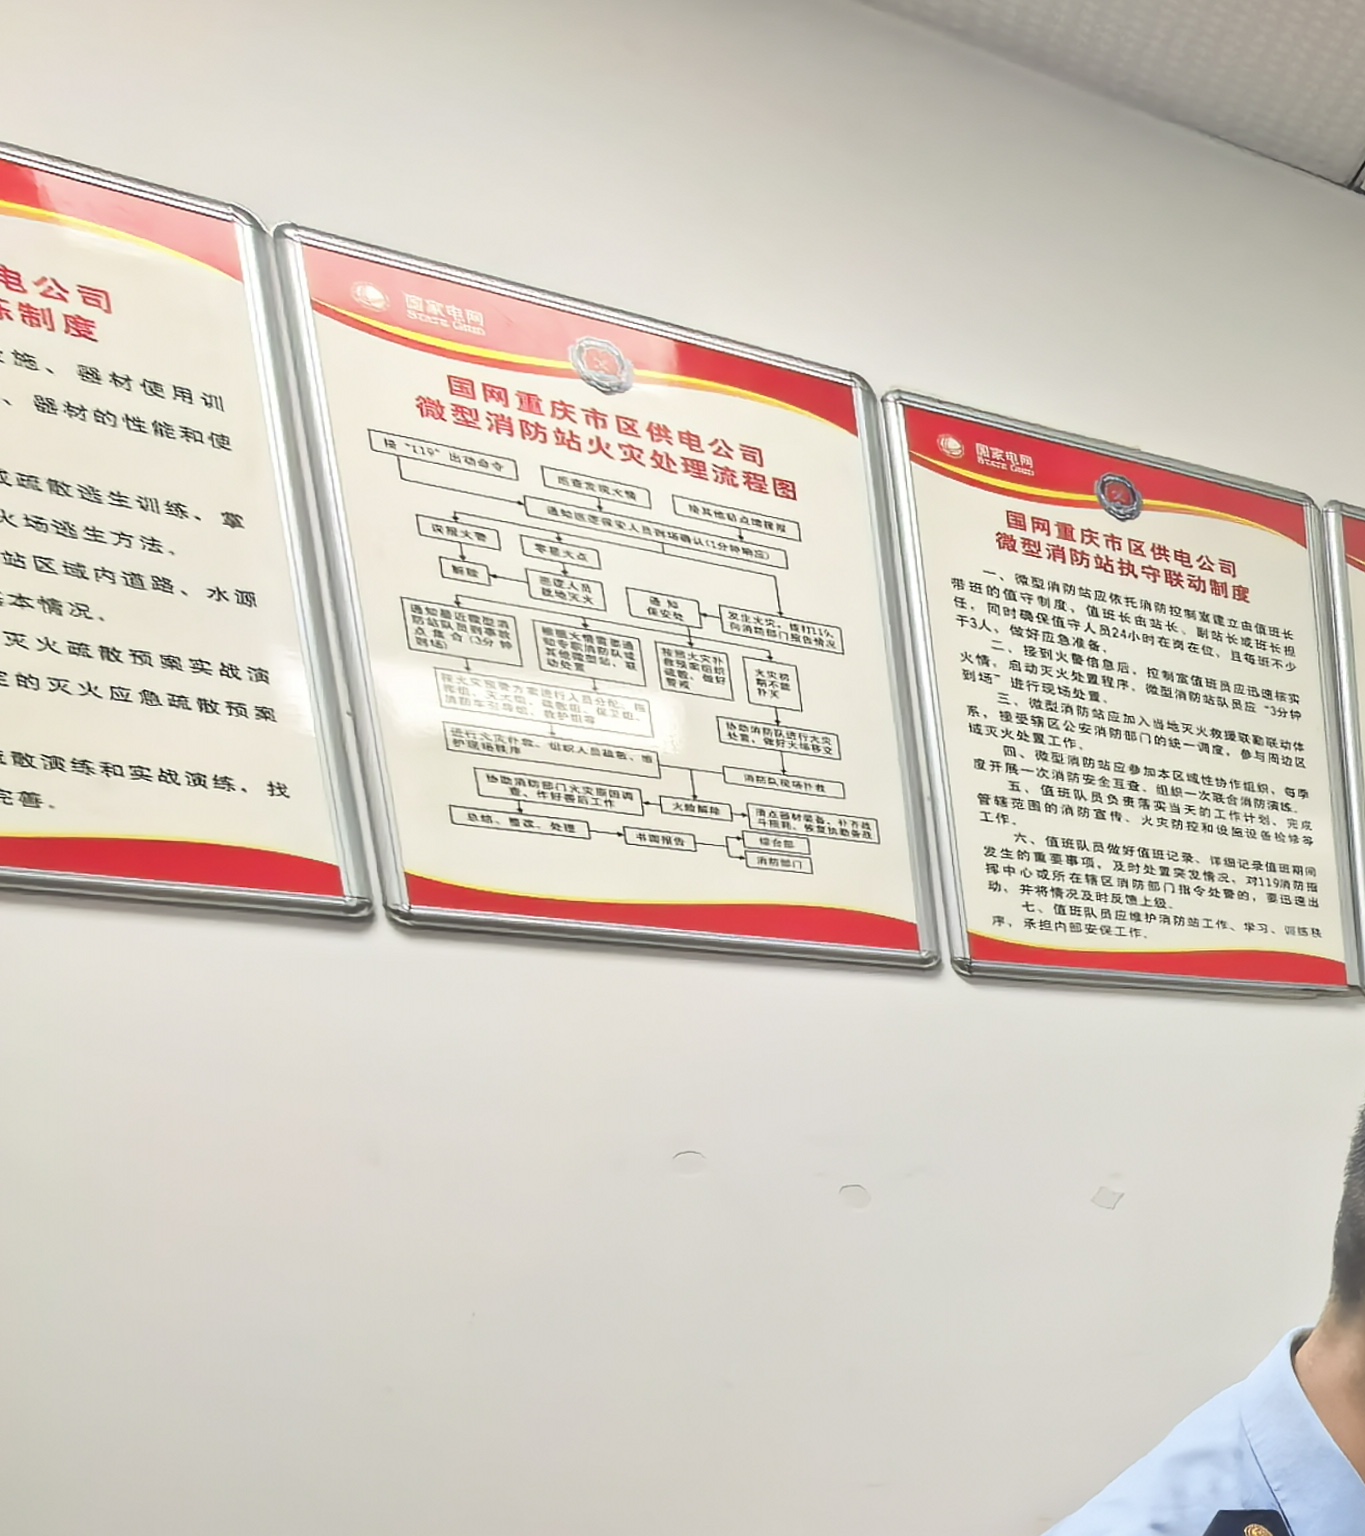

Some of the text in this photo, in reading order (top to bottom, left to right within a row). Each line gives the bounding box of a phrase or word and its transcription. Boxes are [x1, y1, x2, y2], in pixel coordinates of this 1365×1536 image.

[0, 349, 224, 412] 施、器材使用训
[415, 395, 797, 501] 微型消防站火灾处理流程图
[446, 374, 764, 467] 国网重庆市区供电公司
[975, 442, 1033, 470] 国家电网
[995, 531, 1250, 603] 微型消防站执守联动制度
[1005, 509, 1236, 578] 国网重庆市区供电公司
[0, 591, 104, 621] 本情况。
